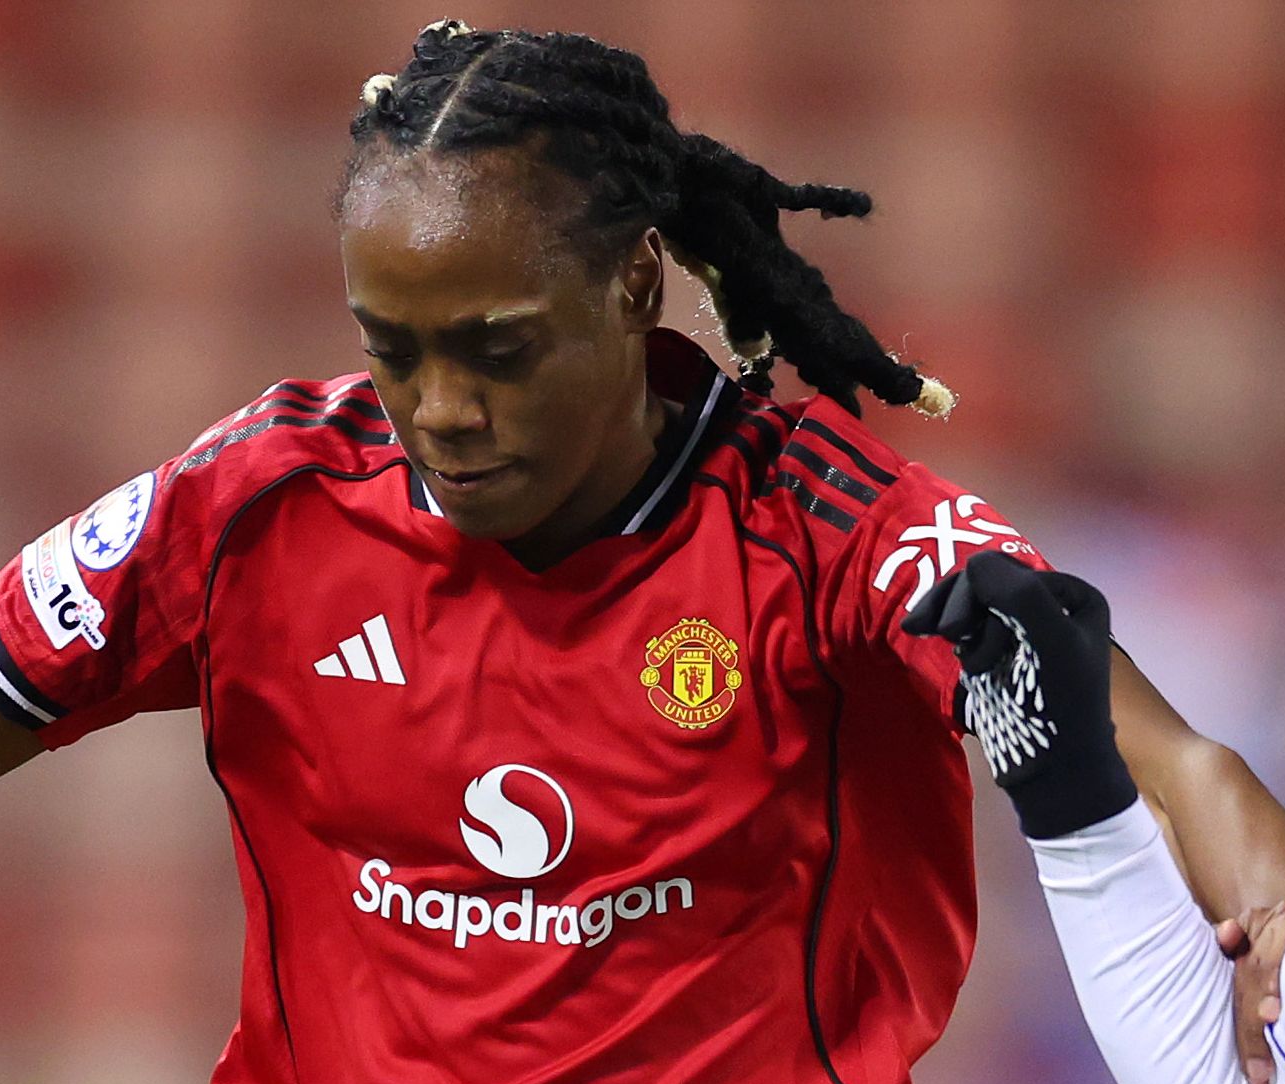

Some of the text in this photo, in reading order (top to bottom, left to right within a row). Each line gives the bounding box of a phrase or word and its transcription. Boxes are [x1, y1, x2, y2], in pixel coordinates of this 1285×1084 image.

[49, 584, 81, 630] 10
[653, 627, 732, 662] MANCHESTER
[665, 701, 722, 721] UNITED
[353, 858, 693, 949] Snapdragon
